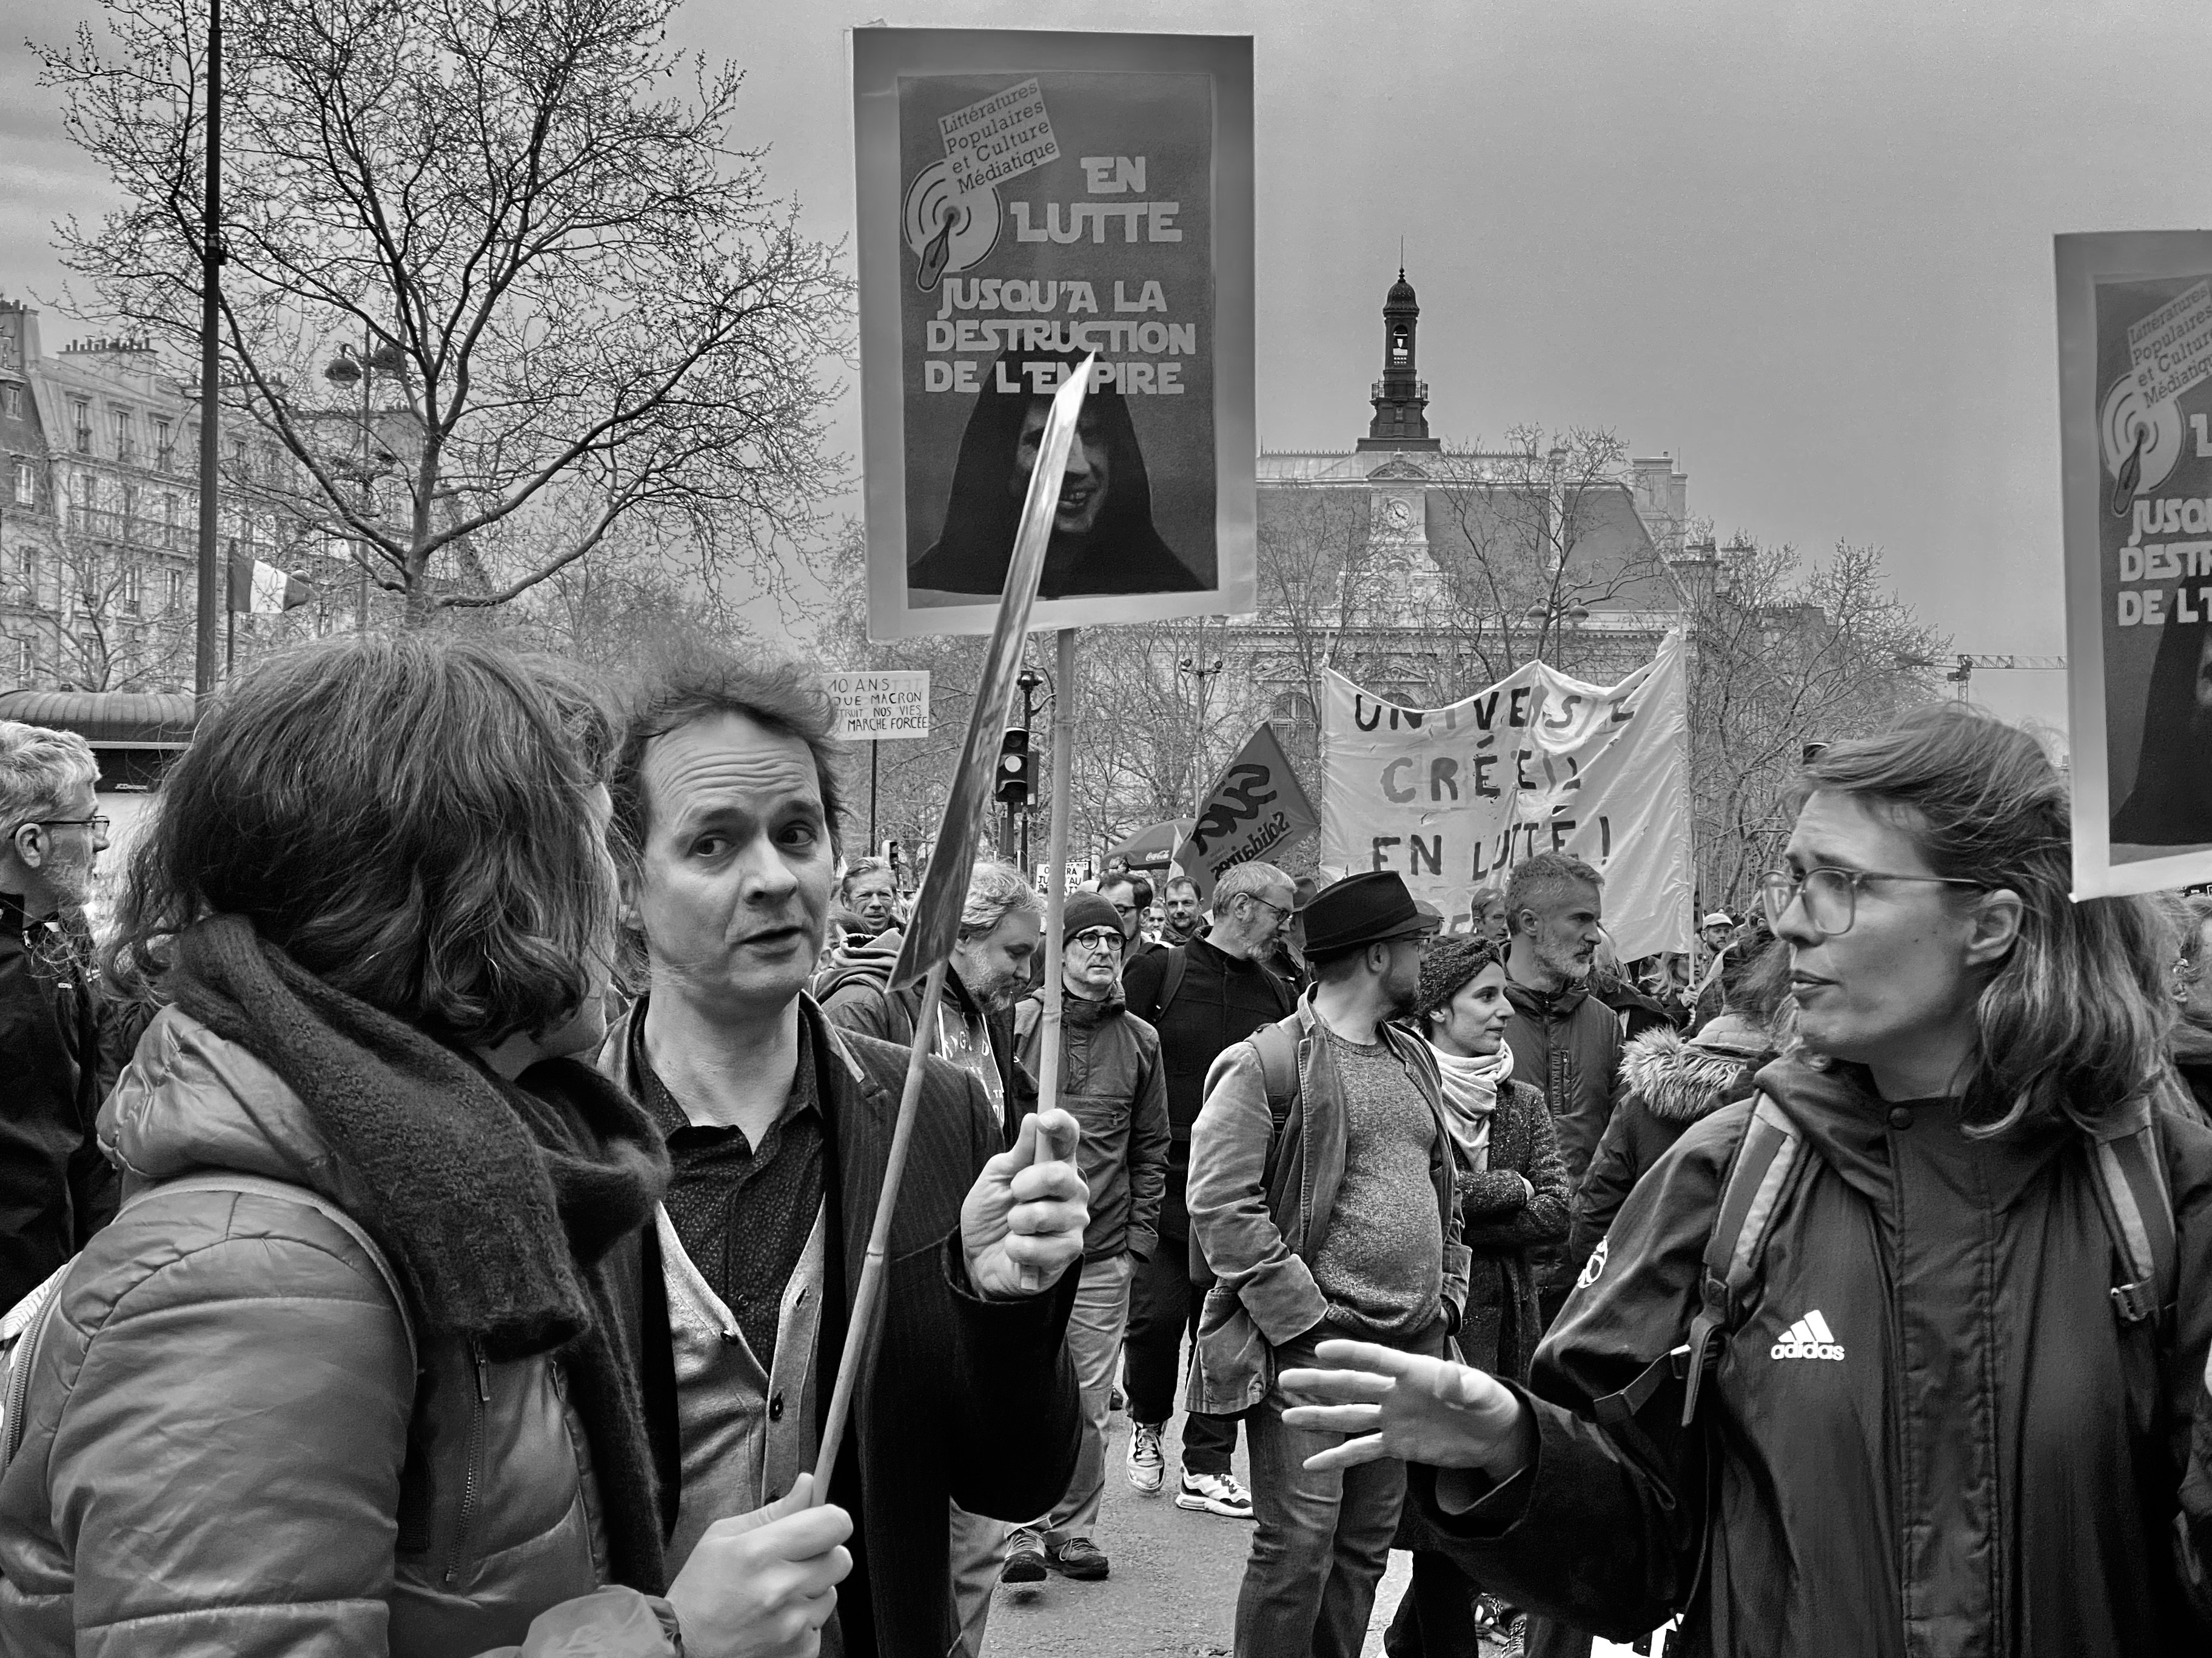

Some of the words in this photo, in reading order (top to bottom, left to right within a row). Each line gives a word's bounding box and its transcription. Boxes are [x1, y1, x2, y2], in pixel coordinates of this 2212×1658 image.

[942, 82, 1037, 135] Littératures
[946, 101, 1044, 155] Populaires
[952, 155, 970, 173] et
[977, 122, 1049, 161] Culture
[957, 142, 1056, 194] Médiatique
[1081, 156, 1145, 193] EN
[1010, 201, 1182, 244] LUTTE
[937, 278, 1098, 320] JUSQU'A
[1114, 281, 1168, 312] LA
[927, 320, 1196, 355] DESTRUCTION
[925, 360, 980, 393] DE
[2138, 366, 2154, 387] et
[2159, 328, 2212, 372] Cultur
[2144, 353, 2212, 409] Médiatiq
[2128, 498, 2212, 546] JUSQ
[2118, 589, 2165, 626] DE
[828, 679, 848, 693] 10
[855, 678, 890, 693] ANS
[871, 691, 922, 705] MACRON
[848, 718, 887, 732] MARCHE
[891, 716, 928, 730] FORCÉE
[873, 706, 892, 717] NOS
[1771, 1340, 1845, 1361] adidas
